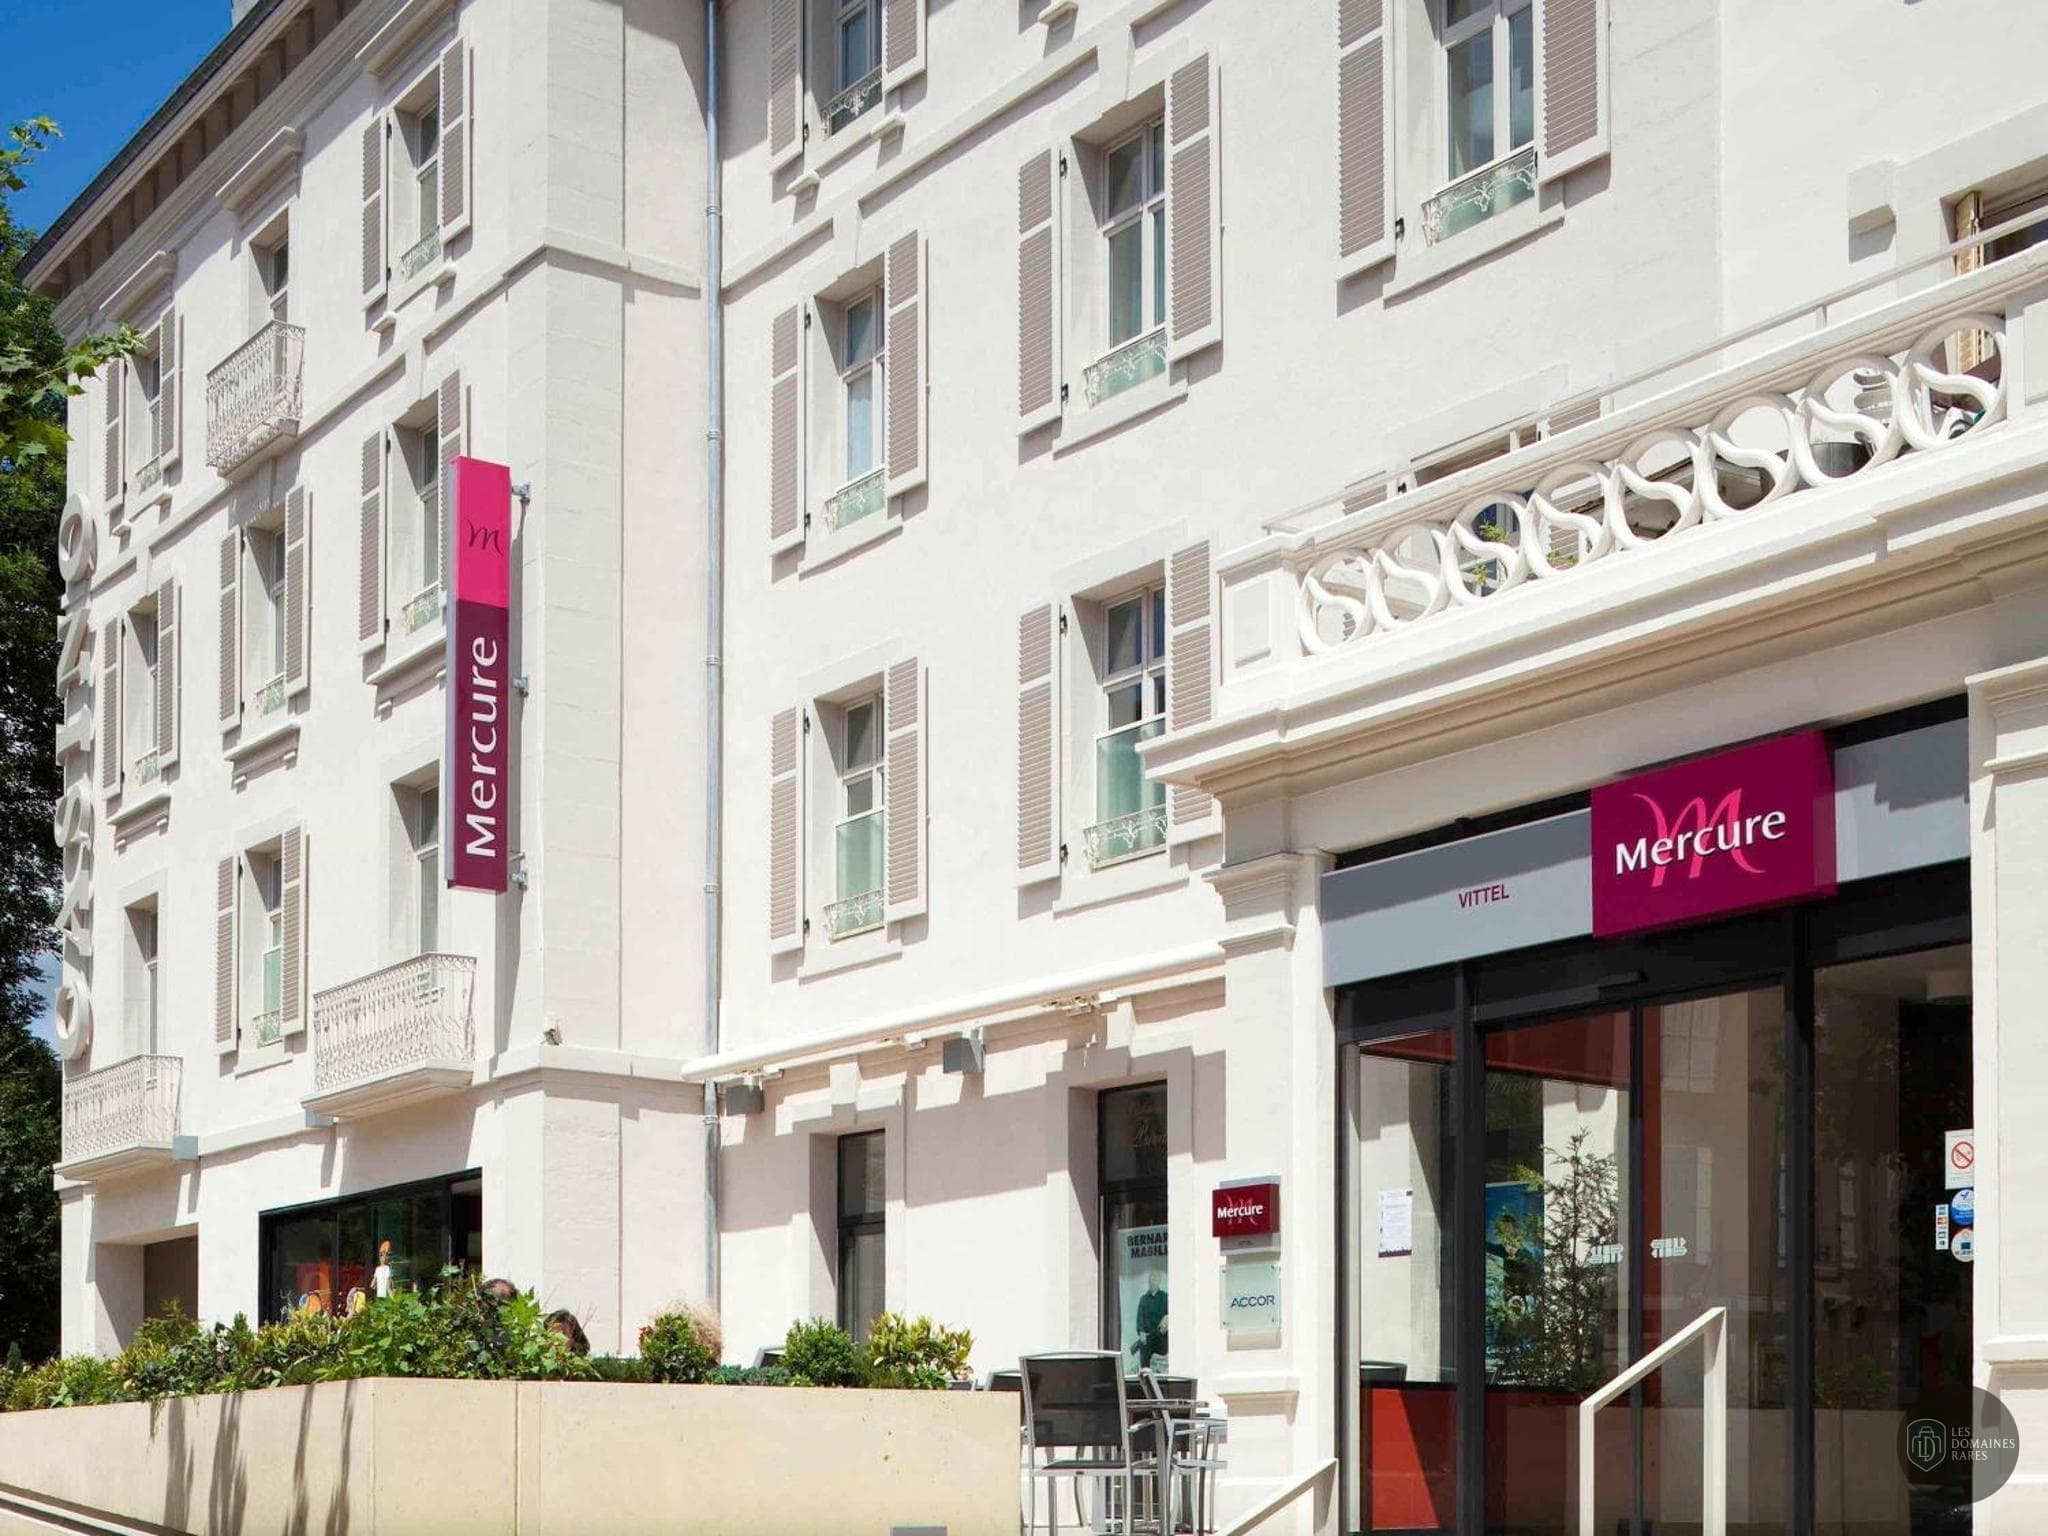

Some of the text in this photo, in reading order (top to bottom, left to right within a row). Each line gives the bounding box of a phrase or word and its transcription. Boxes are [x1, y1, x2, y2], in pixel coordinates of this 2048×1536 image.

[465, 635, 498, 858] Mercure
[54, 493, 96, 1061] CASINO
[1615, 809, 1786, 876] Mercure
[1458, 883, 1510, 909] VITTEL
[1217, 1204, 1264, 1220] Mercure
[1230, 1294, 1275, 1309] ACCOR
